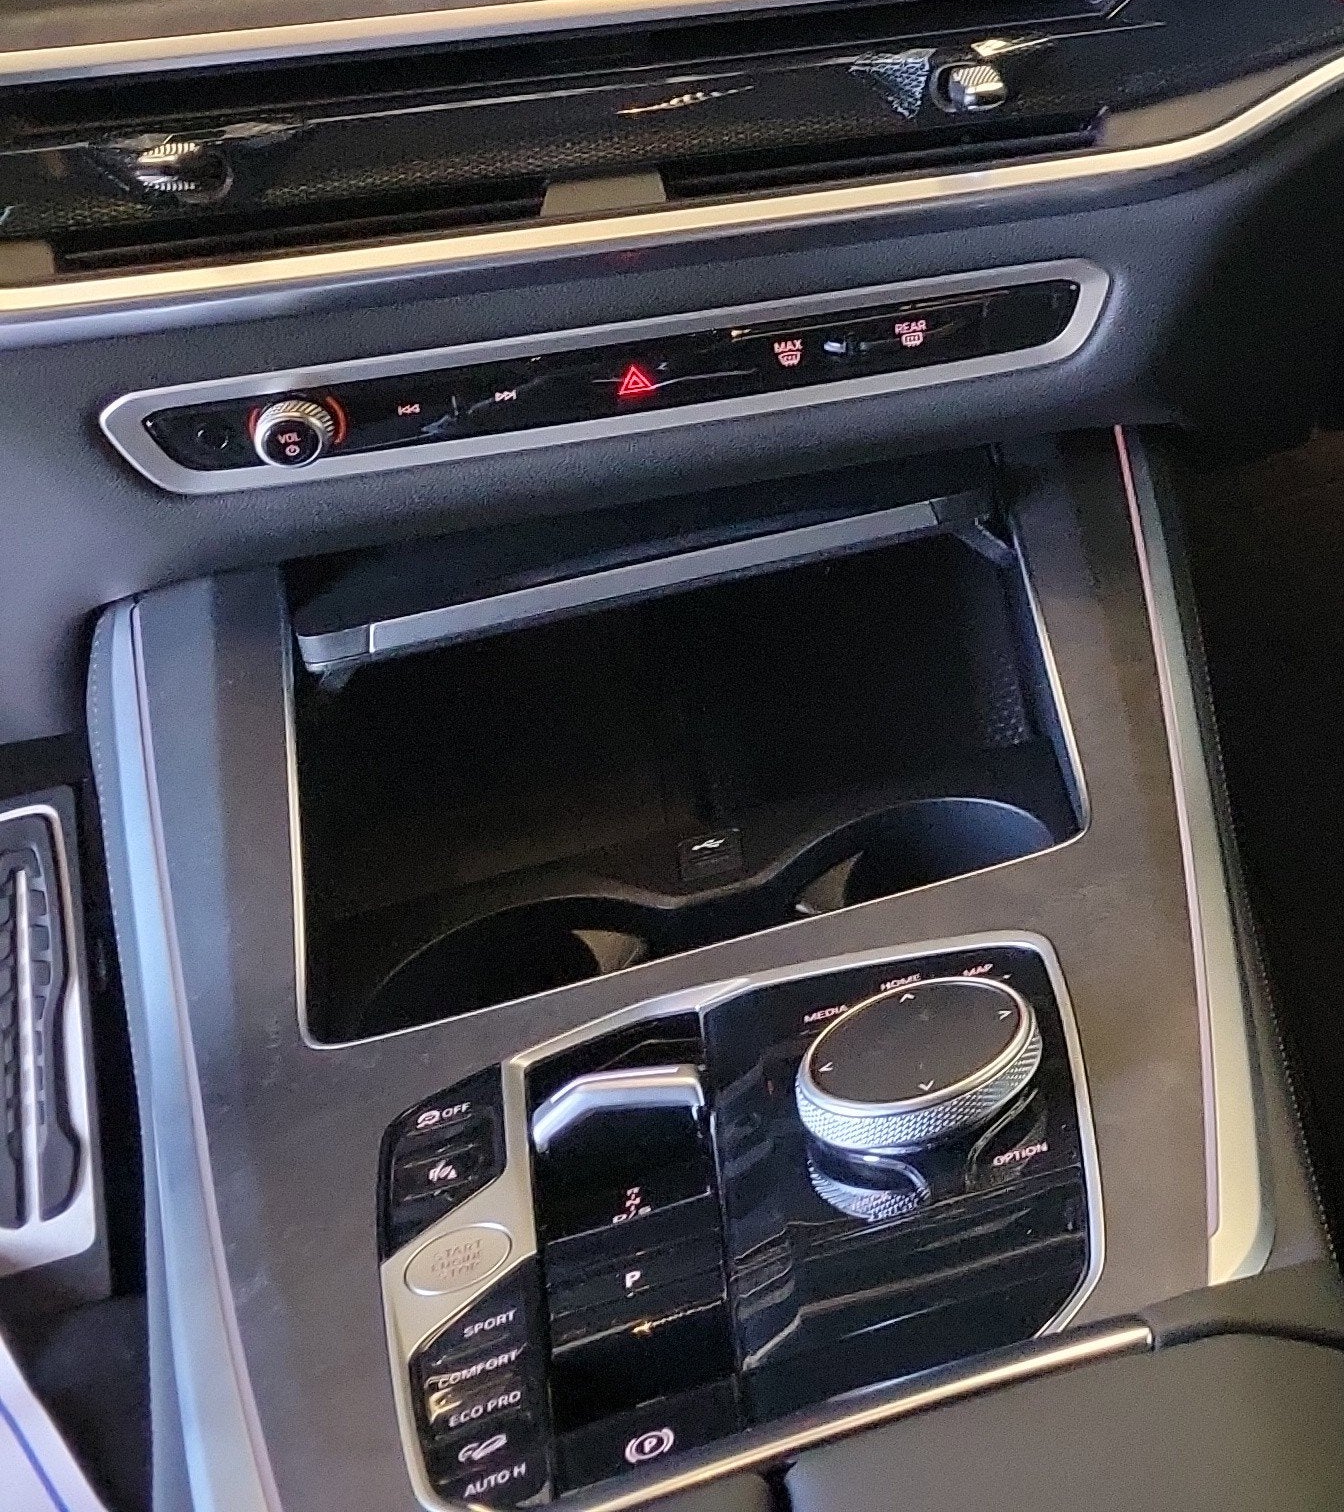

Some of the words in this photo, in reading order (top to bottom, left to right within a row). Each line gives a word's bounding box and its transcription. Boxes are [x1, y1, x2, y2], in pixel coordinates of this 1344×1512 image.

[894, 319, 928, 335] REAR
[773, 338, 804, 354] MAX
[277, 431, 302, 445] VOL
[962, 962, 994, 977] MAP
[879, 972, 923, 992] HOME
[803, 1003, 848, 1024] MEDIA
[441, 1101, 471, 1118] OFF
[992, 1141, 1049, 1166] OPTION
[433, 1239, 482, 1261] START
[430, 1250, 482, 1272] ENGINE
[625, 1270, 641, 1289] P
[463, 1307, 517, 1338] SPORT
[437, 1348, 519, 1389] COMFORT
[449, 1405, 483, 1428] ECO
[487, 1390, 521, 1413] PRO
[463, 1469, 511, 1498] AUTO
[513, 1461, 527, 1479] H
